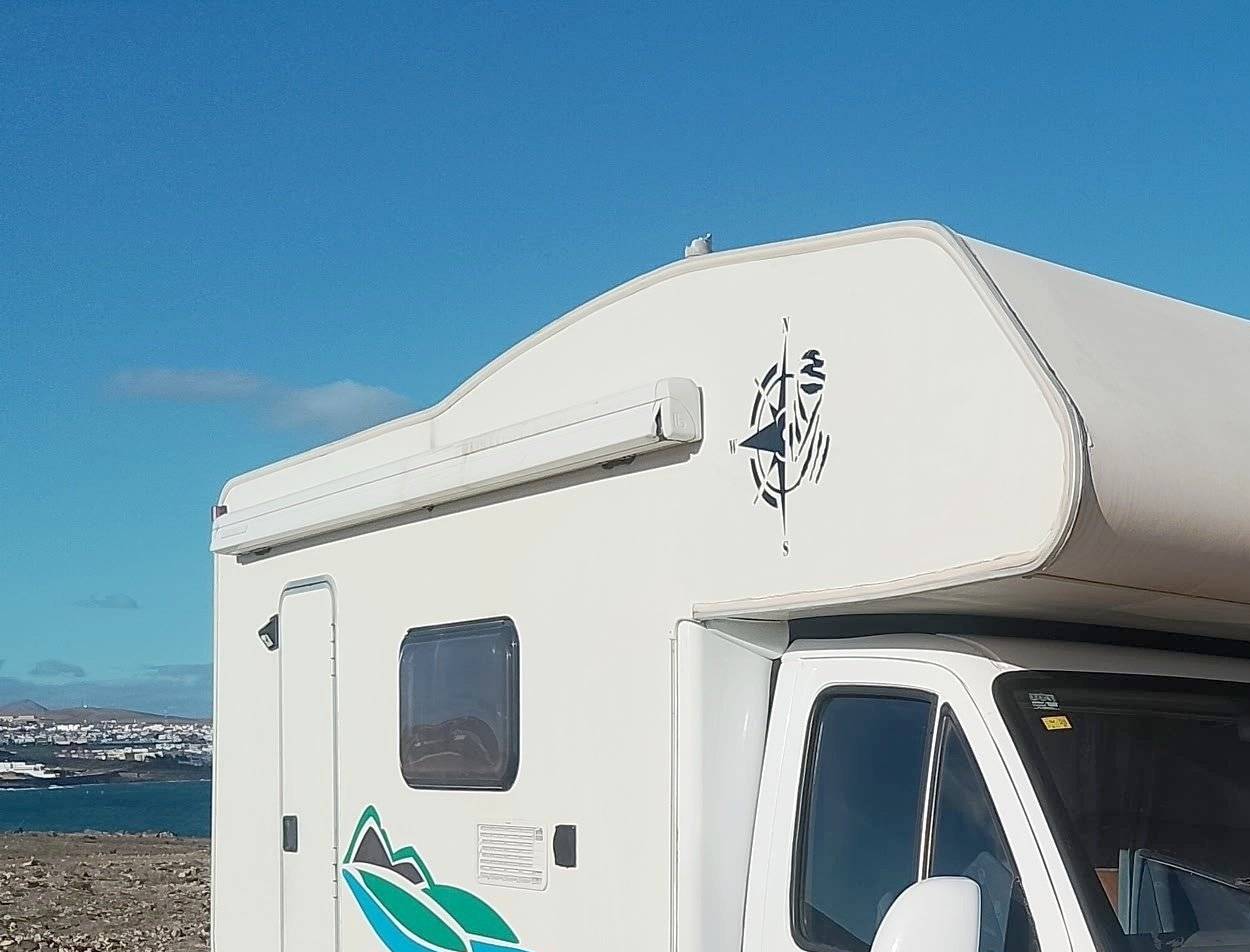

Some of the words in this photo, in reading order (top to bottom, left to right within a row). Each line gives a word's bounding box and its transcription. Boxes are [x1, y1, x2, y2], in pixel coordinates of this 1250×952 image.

[782, 316, 790, 334] N
[729, 439, 738, 455] W
[782, 540, 789, 557] S
